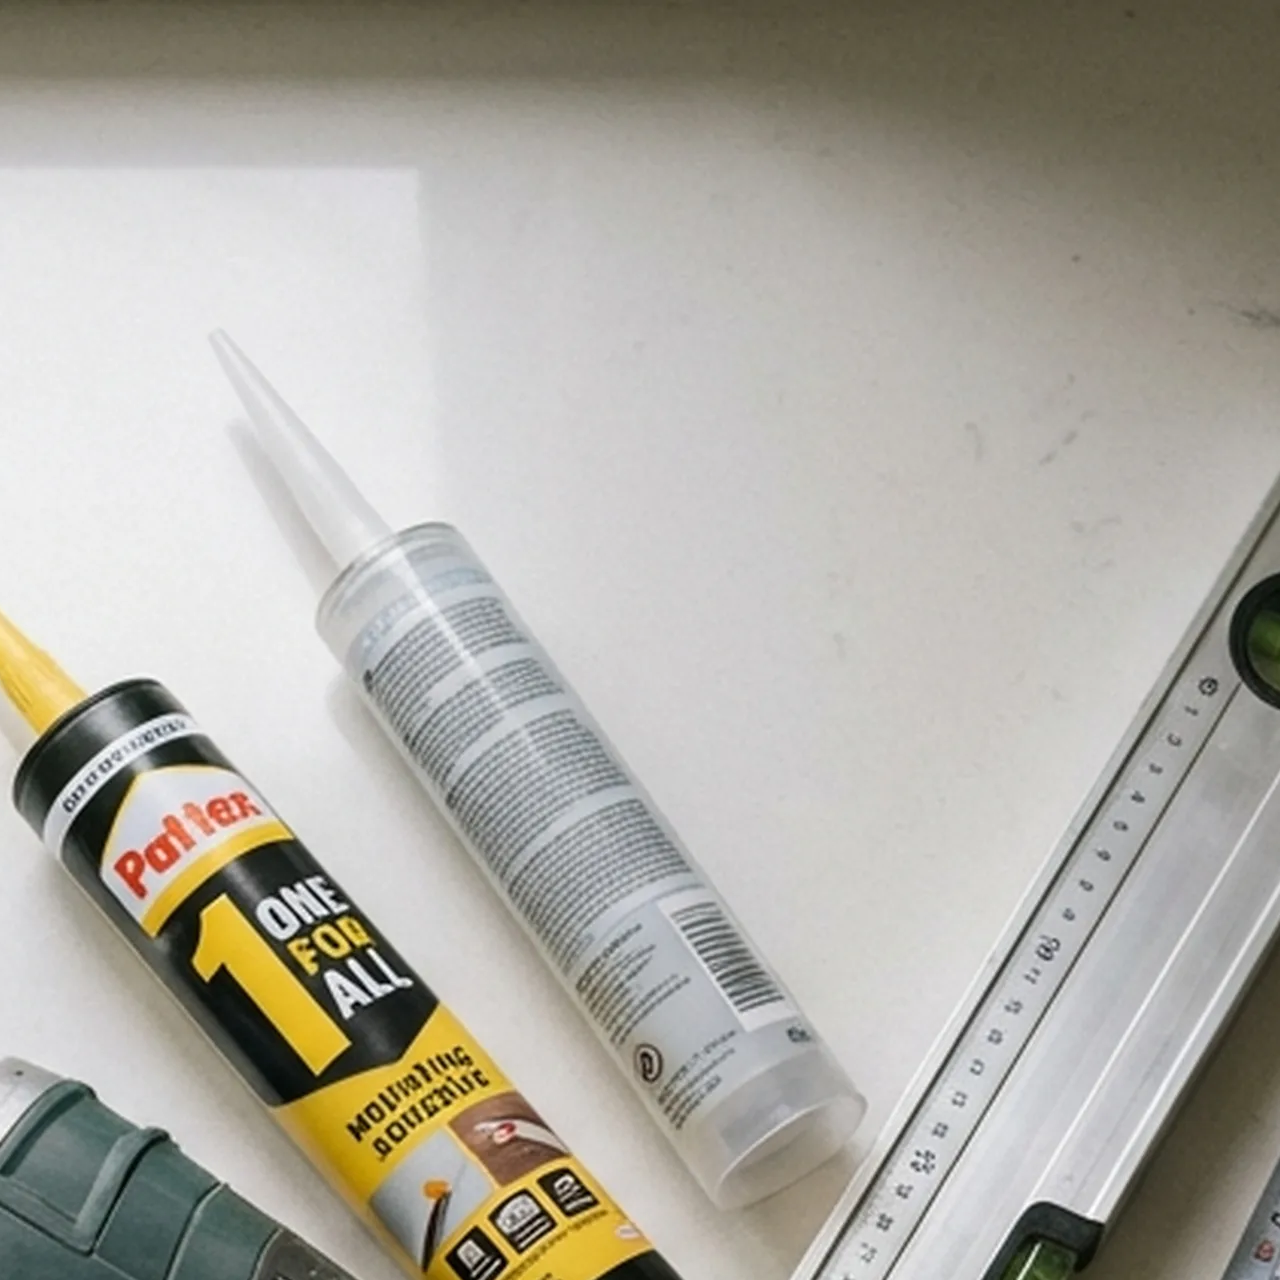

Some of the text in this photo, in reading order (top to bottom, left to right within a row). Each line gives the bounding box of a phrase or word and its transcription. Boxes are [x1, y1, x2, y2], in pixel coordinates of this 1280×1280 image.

[255, 876, 349, 941] ONE
[192, 892, 352, 1077] 1
[323, 948, 414, 1020] ALL
